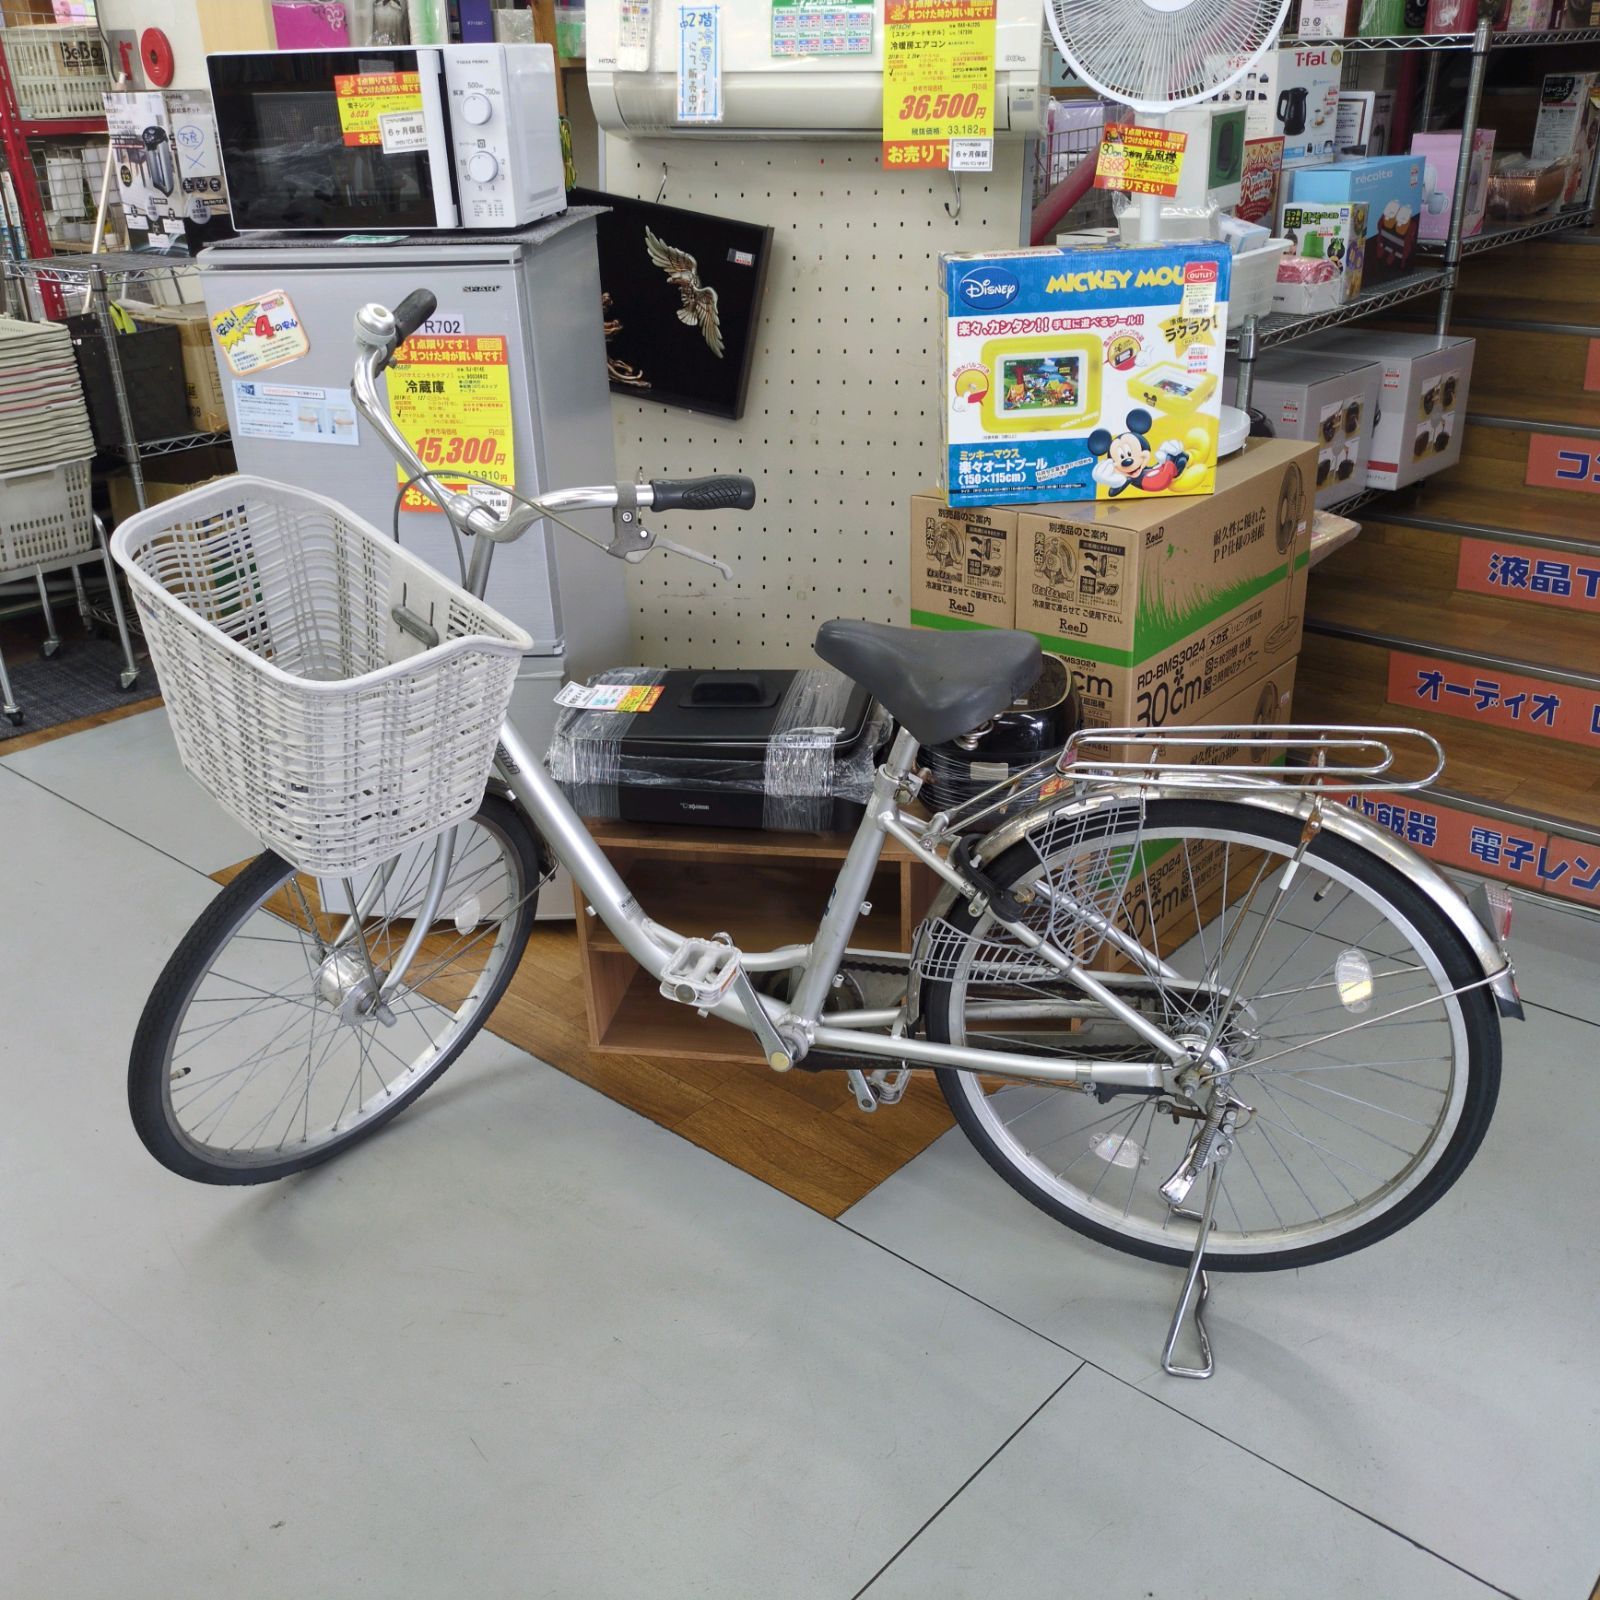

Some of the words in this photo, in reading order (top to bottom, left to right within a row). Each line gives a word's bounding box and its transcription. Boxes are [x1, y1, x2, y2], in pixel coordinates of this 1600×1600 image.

[890, 40, 946, 50] 冷暖房エアコン
[1295, 51, 1327, 67] T-fal
[899, 93, 987, 121] 36,500円
[1046, 266, 1133, 294] MICKEY
[424, 320, 461, 334] R702
[958, 317, 1050, 337] 楽々、カンタン!!
[1052, 314, 1144, 330] 手軽に遊べるプール!!
[409, 338, 470, 350] 1点限りです!
[409, 350, 503, 361] 見つけた時が買い時です!
[405, 380, 445, 394] 冷蔵庫
[416, 437, 506, 466] 15,300円
[960, 448, 1020, 461] ミッキーマウス
[959, 458, 1048, 474] 楽々オートプール
[938, 508, 992, 526] 別売品のご案内
[926, 517, 935, 549] 発売中
[1049, 523, 1108, 541] 別売品のご案内
[1213, 506, 1266, 547] 耐久性に優れた
[1145, 526, 1165, 546] ReeD
[1034, 532, 1045, 566] 発売中
[949, 599, 975, 613] ReeD
[970, 590, 1006, 604] ご使用下さい。
[1033, 599, 1080, 615] 冷凍室で凍らせて
[1083, 610, 1123, 624] ご使用下さい。
[1060, 618, 1088, 633] ReeD
[1209, 628, 1229, 649] メカ式
[1137, 638, 1206, 690] RD-BMS3024
[1416, 671, 1561, 726] オーディオ
